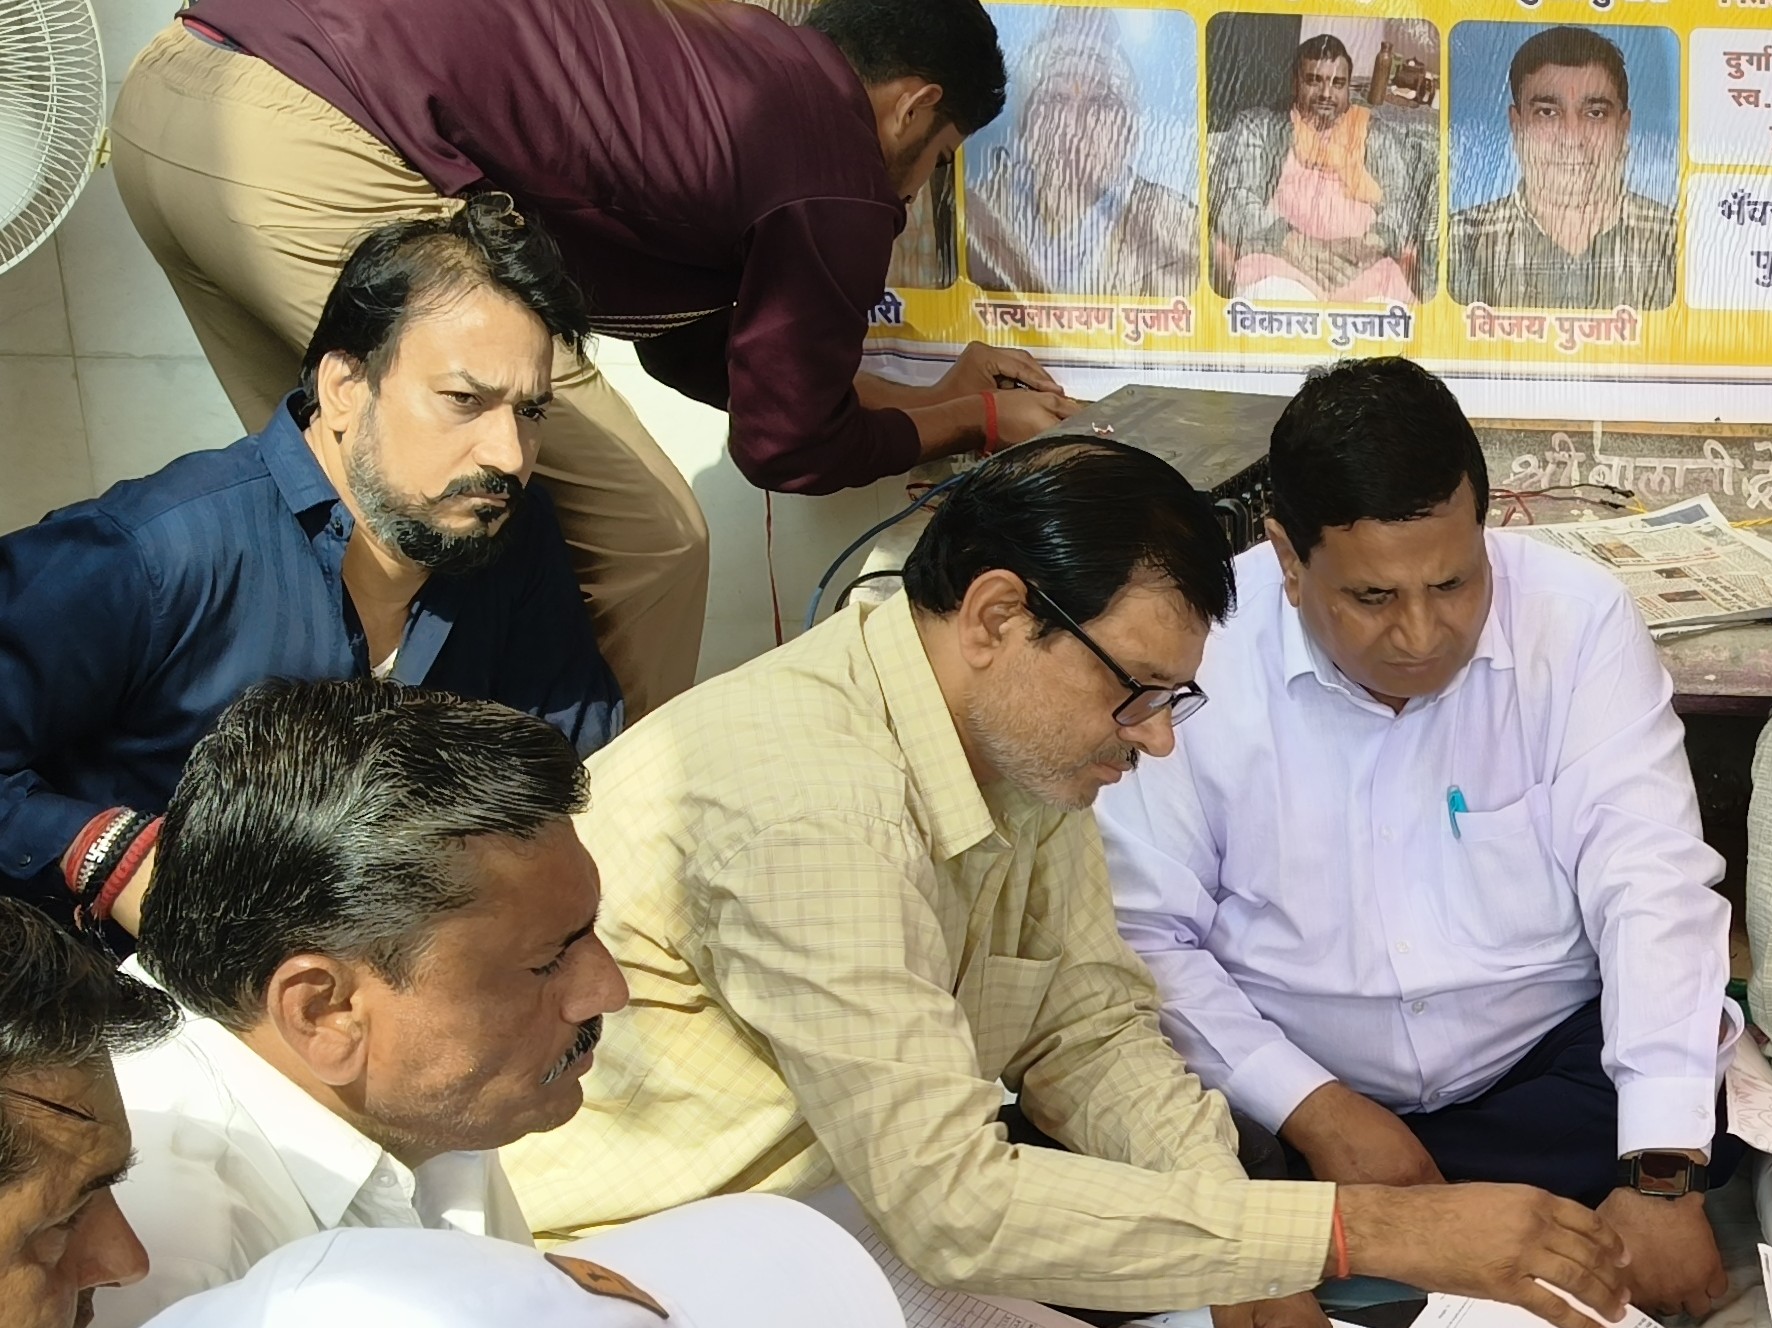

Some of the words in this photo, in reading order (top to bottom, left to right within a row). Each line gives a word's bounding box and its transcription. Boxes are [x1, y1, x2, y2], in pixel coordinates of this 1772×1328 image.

[1722, 44, 1772, 79] दुर्गा
[1121, 300, 1192, 339] पुजारी
[1228, 305, 1319, 337] विकास
[1330, 306, 1412, 344] पुजारी
[1466, 309, 1546, 341] विजय
[1554, 311, 1638, 349] पुजारी
